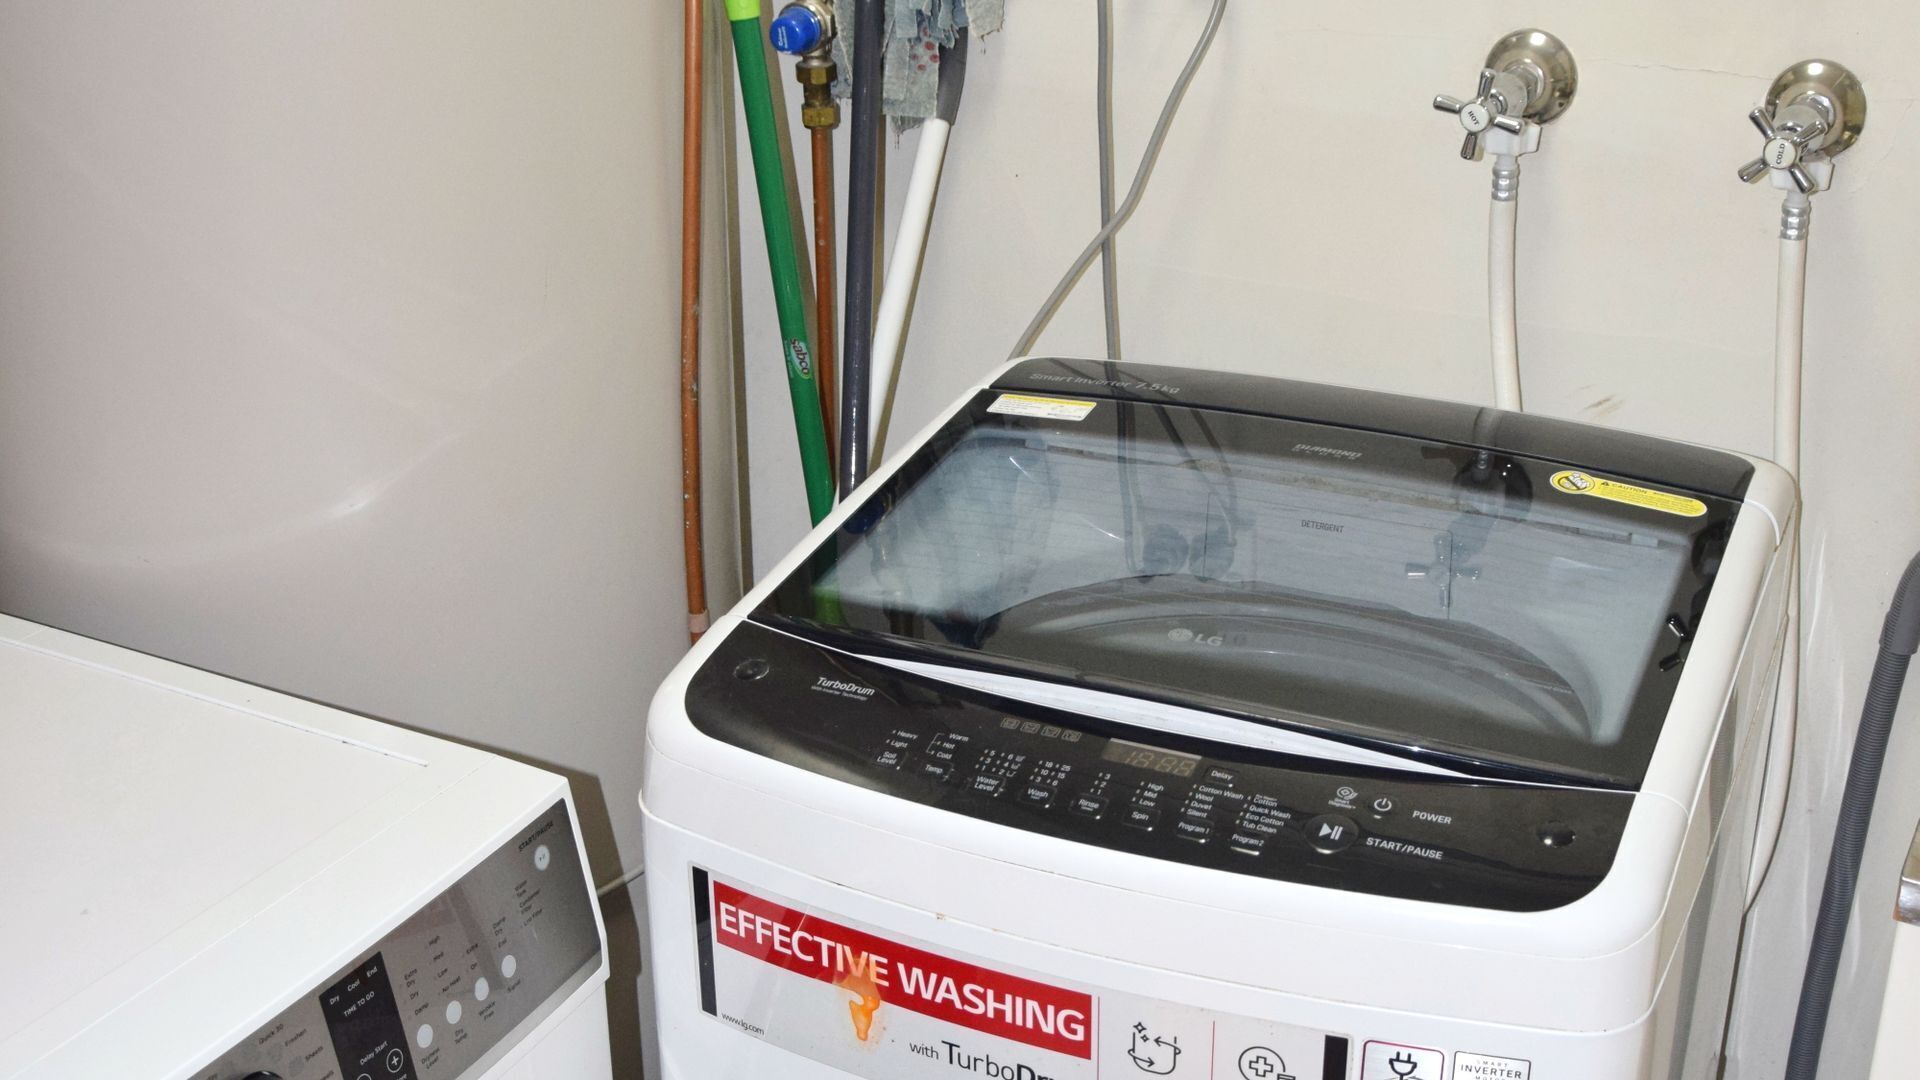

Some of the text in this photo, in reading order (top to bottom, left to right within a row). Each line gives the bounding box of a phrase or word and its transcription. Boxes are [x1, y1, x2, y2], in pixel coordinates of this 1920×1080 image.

[1468, 111, 1480, 125] HOT
[1776, 143, 1785, 165] COLD
[1301, 519, 1345, 533] DETERGENT
[1195, 633, 1223, 647] LG
[816, 676, 875, 696] TurboDrum
[897, 730, 918, 740] Heavy
[949, 733, 969, 742] Warm
[890, 740, 908, 749] Light
[943, 742, 955, 750] Hot
[877, 756, 896, 765] Level
[883, 751, 897, 759] Soil
[936, 751, 952, 759] Cold
[976, 775, 999, 786] Water
[1211, 770, 1234, 781] Delay
[974, 782, 995, 792] Level
[1027, 787, 1049, 798] Wash
[1148, 782, 1164, 792] High
[1143, 790, 1158, 799] Mid
[1195, 793, 1214, 802] Wool
[1199, 785, 1223, 796] Cotton
[1224, 789, 1244, 801] Wash
[1079, 798, 1100, 809] Rinse
[1139, 798, 1156, 807] Low
[1190, 800, 1212, 811] Duvet
[1253, 797, 1278, 807] Cotton
[1131, 811, 1149, 822] Spin
[1186, 808, 1208, 819] Silent
[1249, 804, 1291, 819] Quick Wash
[1245, 812, 1284, 826] Eco Cotton
[1412, 810, 1452, 825] POWER
[1178, 822, 1205, 834] Program
[1242, 820, 1277, 834] Tub Clean
[1232, 833, 1259, 846] Program
[1366, 837, 1443, 860] START/PAUSE
[404, 968, 418, 981] Extra
[719, 901, 1085, 1041] EFFECTIVE WASHING
[329, 966, 378, 1006] Dry Cool End
[406, 979, 416, 989] Dry
[410, 990, 420, 1001] Dry
[343, 991, 375, 1018] TIME TO GO
[720, 1012, 766, 1037] www.lg.com
[360, 1040, 389, 1066] Delay Start
[909, 1039, 1055, 1080] with TurboD
[1460, 1063, 1522, 1079] INVERTER
